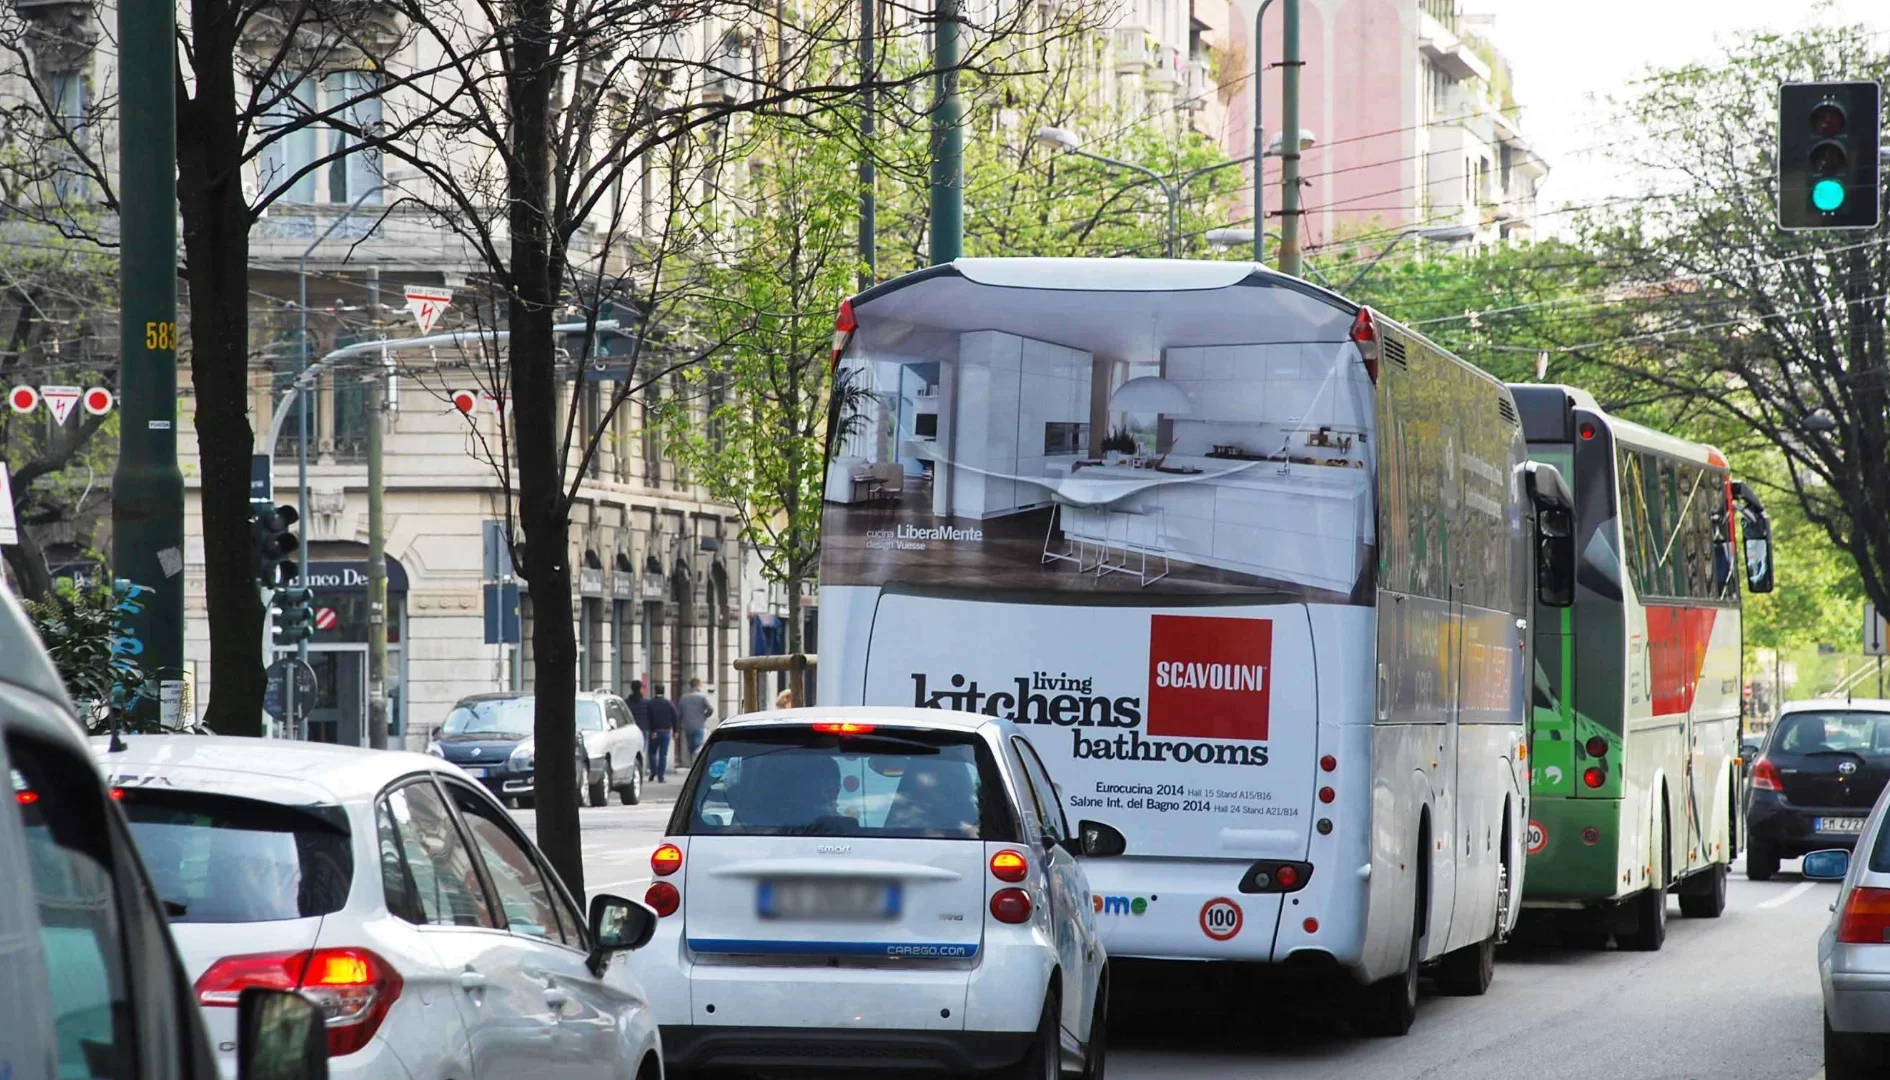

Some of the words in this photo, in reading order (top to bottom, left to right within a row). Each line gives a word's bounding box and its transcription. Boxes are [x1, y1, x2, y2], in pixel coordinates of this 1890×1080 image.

[866, 528, 894, 539] cucina
[897, 524, 983, 541] LiberaMente
[866, 539, 894, 551] design
[896, 540, 926, 551] Vuesse
[288, 573, 340, 587] nco
[1032, 671, 1092, 694] living
[1156, 661, 1263, 691] SCAVOLINI
[911, 673, 1141, 728] kitchens
[1072, 728, 1269, 767] bathrooms
[1096, 781, 1153, 795] Eurocucina
[1156, 784, 1184, 796] 2014
[1188, 788, 1202, 797] Hall
[1205, 789, 1214, 798] 15
[1216, 789, 1237, 799] Stand
[1239, 791, 1272, 801] A15/B16
[1106, 797, 1123, 808] Int.
[1127, 798, 1143, 809] del
[1146, 798, 1180, 812] Bagno
[1182, 800, 1211, 812] 2014
[1214, 805, 1228, 813] Hall
[1230, 805, 1240, 814] 24
[1242, 806, 1264, 815] Stand
[1265, 807, 1298, 817] A21/B14
[817, 844, 851, 854] smart
[1208, 909, 1236, 927] 100
[886, 945, 965, 956] CAR2GO.COM
